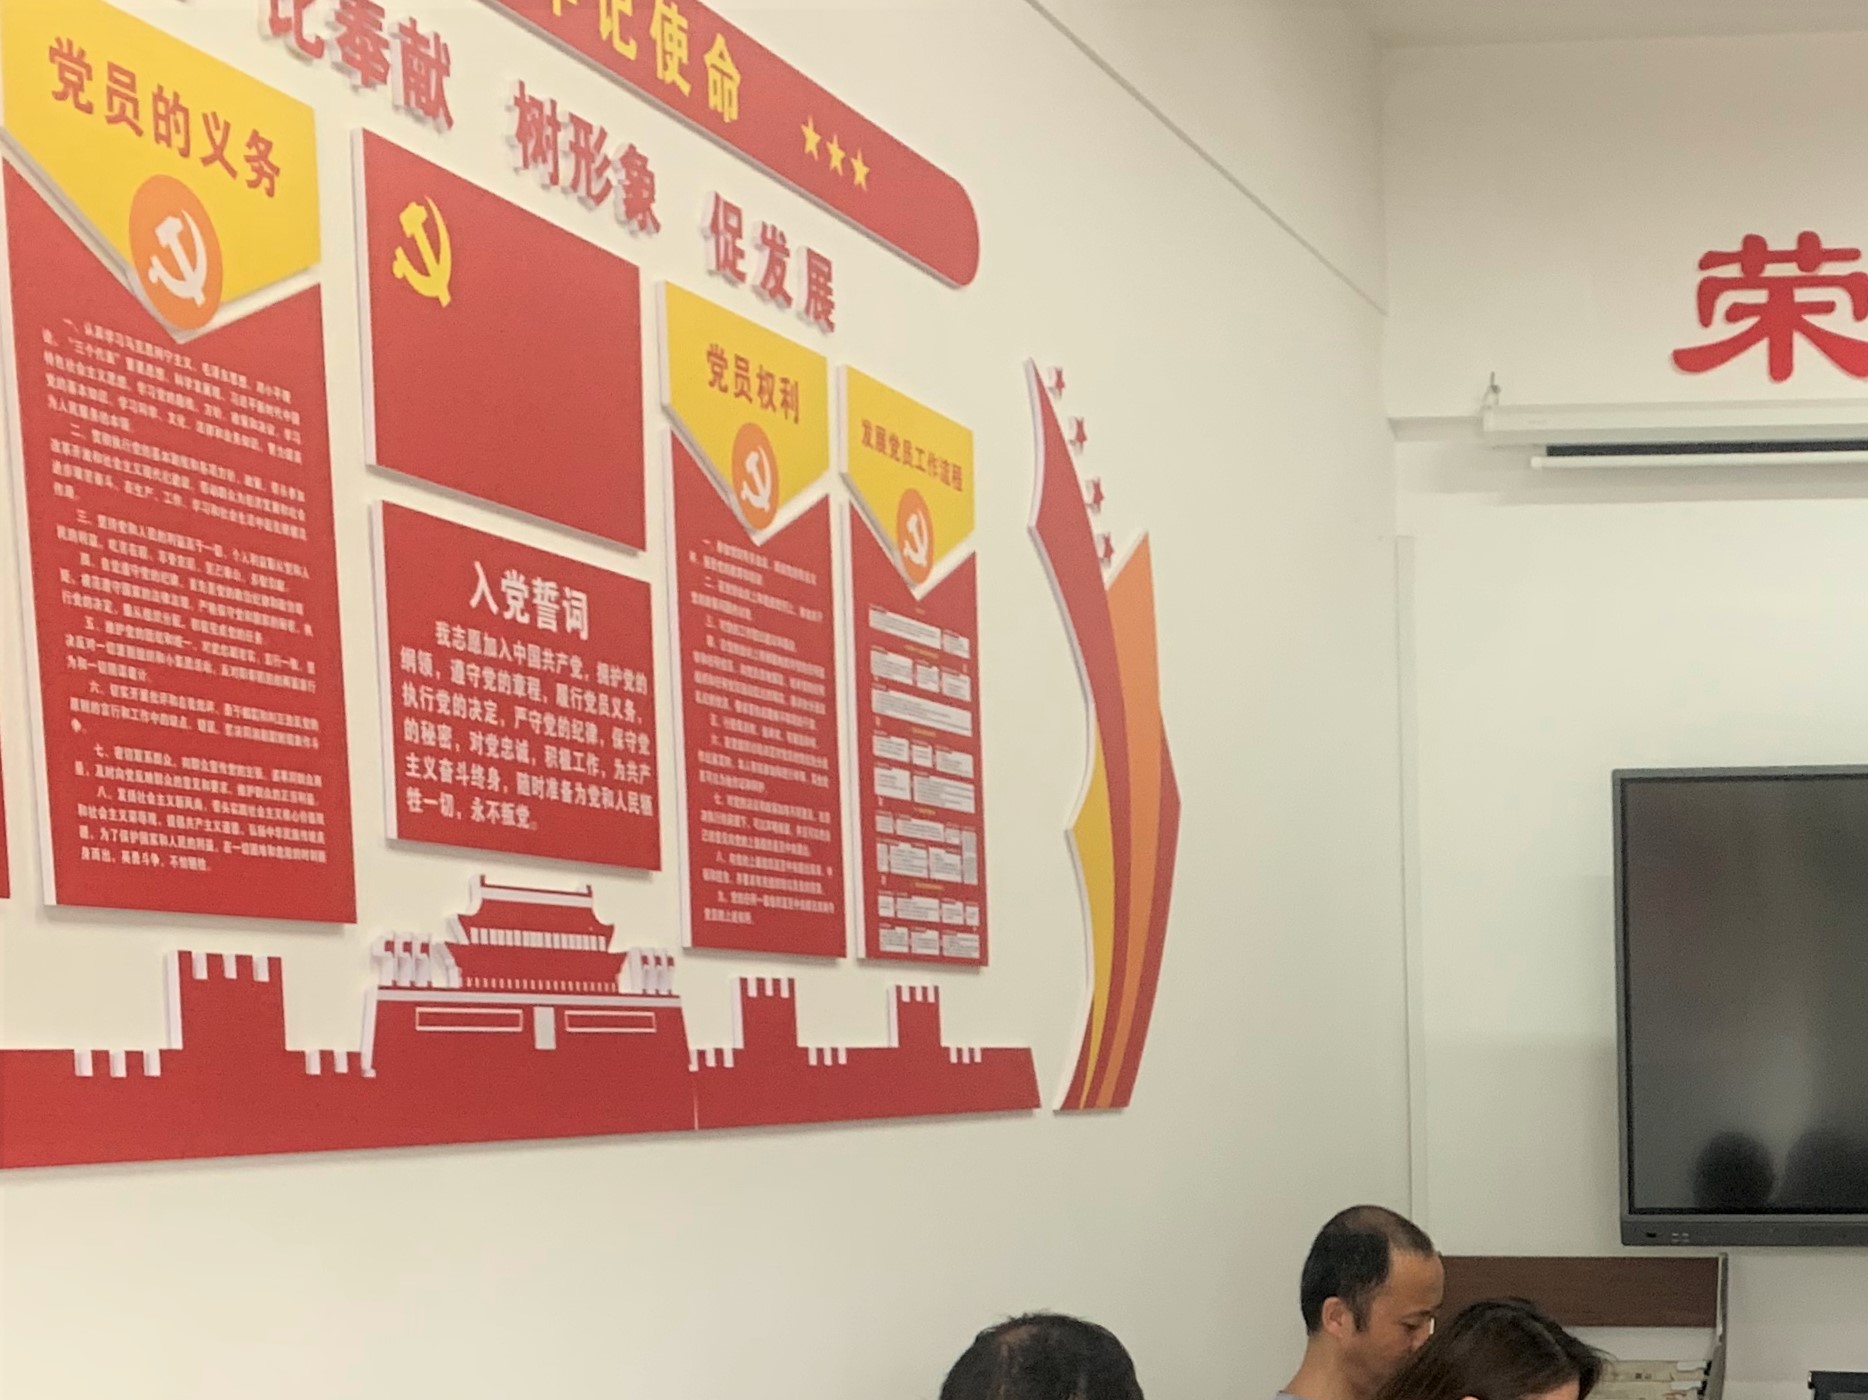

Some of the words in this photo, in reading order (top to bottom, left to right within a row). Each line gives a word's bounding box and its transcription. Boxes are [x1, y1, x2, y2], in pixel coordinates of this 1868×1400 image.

[553, 0, 741, 123] 记使命
[48, 35, 282, 199] 党员的义务
[513, 79, 661, 233] 树形象
[706, 190, 836, 333] 促发展
[706, 342, 800, 425] 党员权利
[860, 417, 964, 493] 发展党员工作流程
[469, 561, 589, 640] 入党誓词
